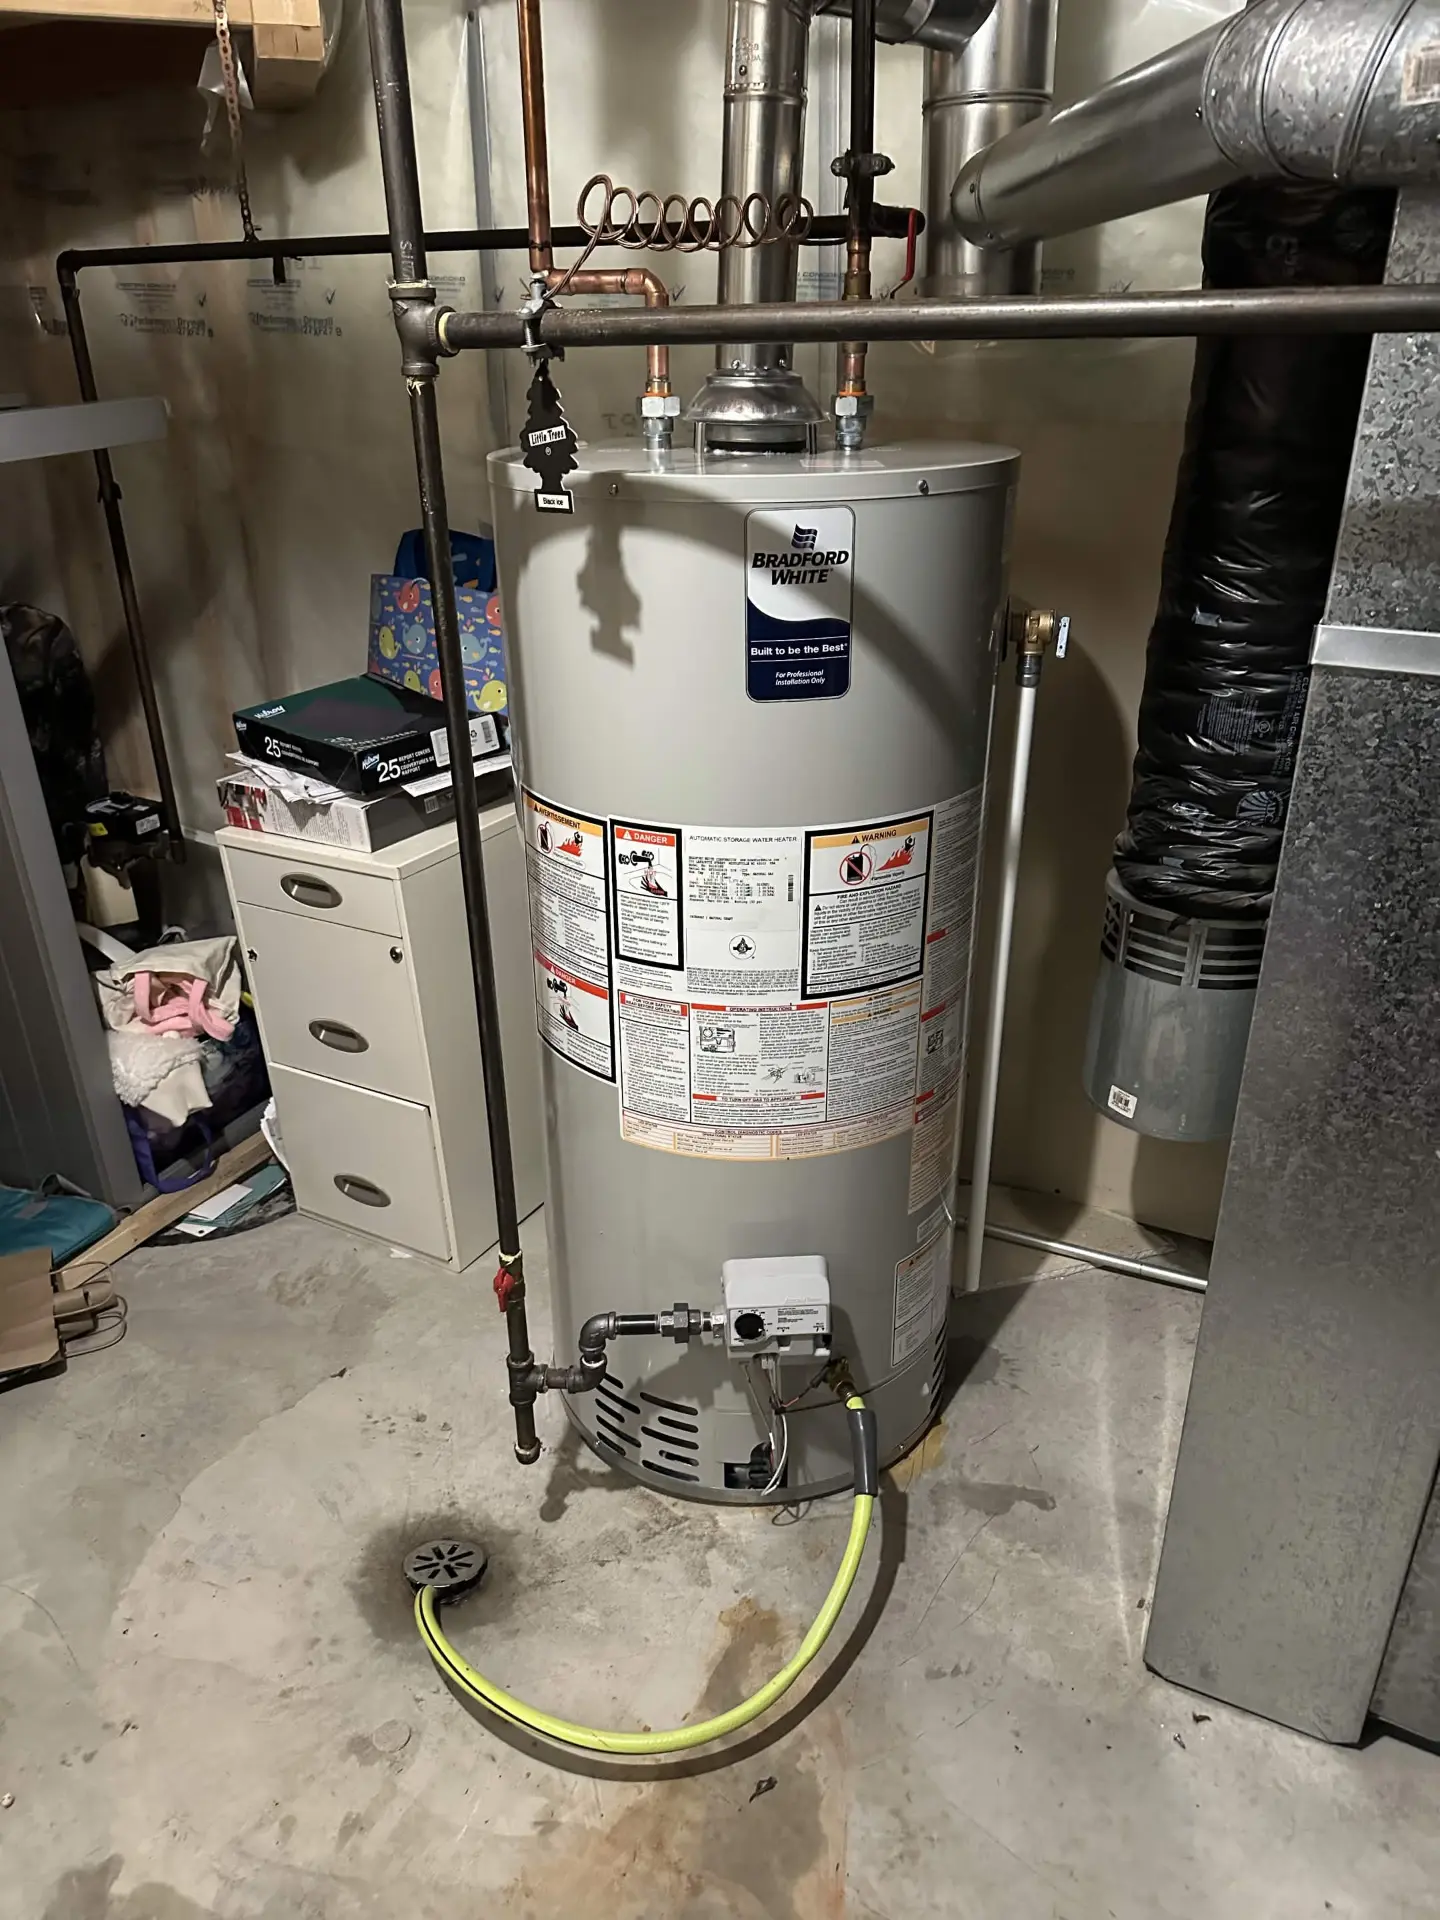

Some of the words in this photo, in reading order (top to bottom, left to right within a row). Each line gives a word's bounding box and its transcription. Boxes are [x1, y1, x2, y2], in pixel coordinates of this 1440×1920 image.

[531, 432, 546, 444] Little
[547, 430, 564, 440] Trees
[752, 550, 849, 568] BRADFORD
[771, 568, 828, 585] WHITE
[751, 647, 772, 655] Built
[775, 647, 785, 655] to
[788, 645, 800, 654] be
[804, 645, 819, 653] the
[786, 670, 824, 678] Professional
[776, 678, 810, 686] Installation
[264, 736, 281, 758] 25
[399, 751, 414, 762] REPORT
[415, 748, 430, 757] COVERS
[377, 758, 401, 783] 25
[401, 759, 429, 770] COUVERTURES
[538, 807, 581, 829] AVERTISSEMENT
[634, 833, 668, 844] DANGER
[862, 830, 896, 842] WARNING
[859, 888, 884, 896] EXPLOSION
[555, 968, 576, 985] DANGER
